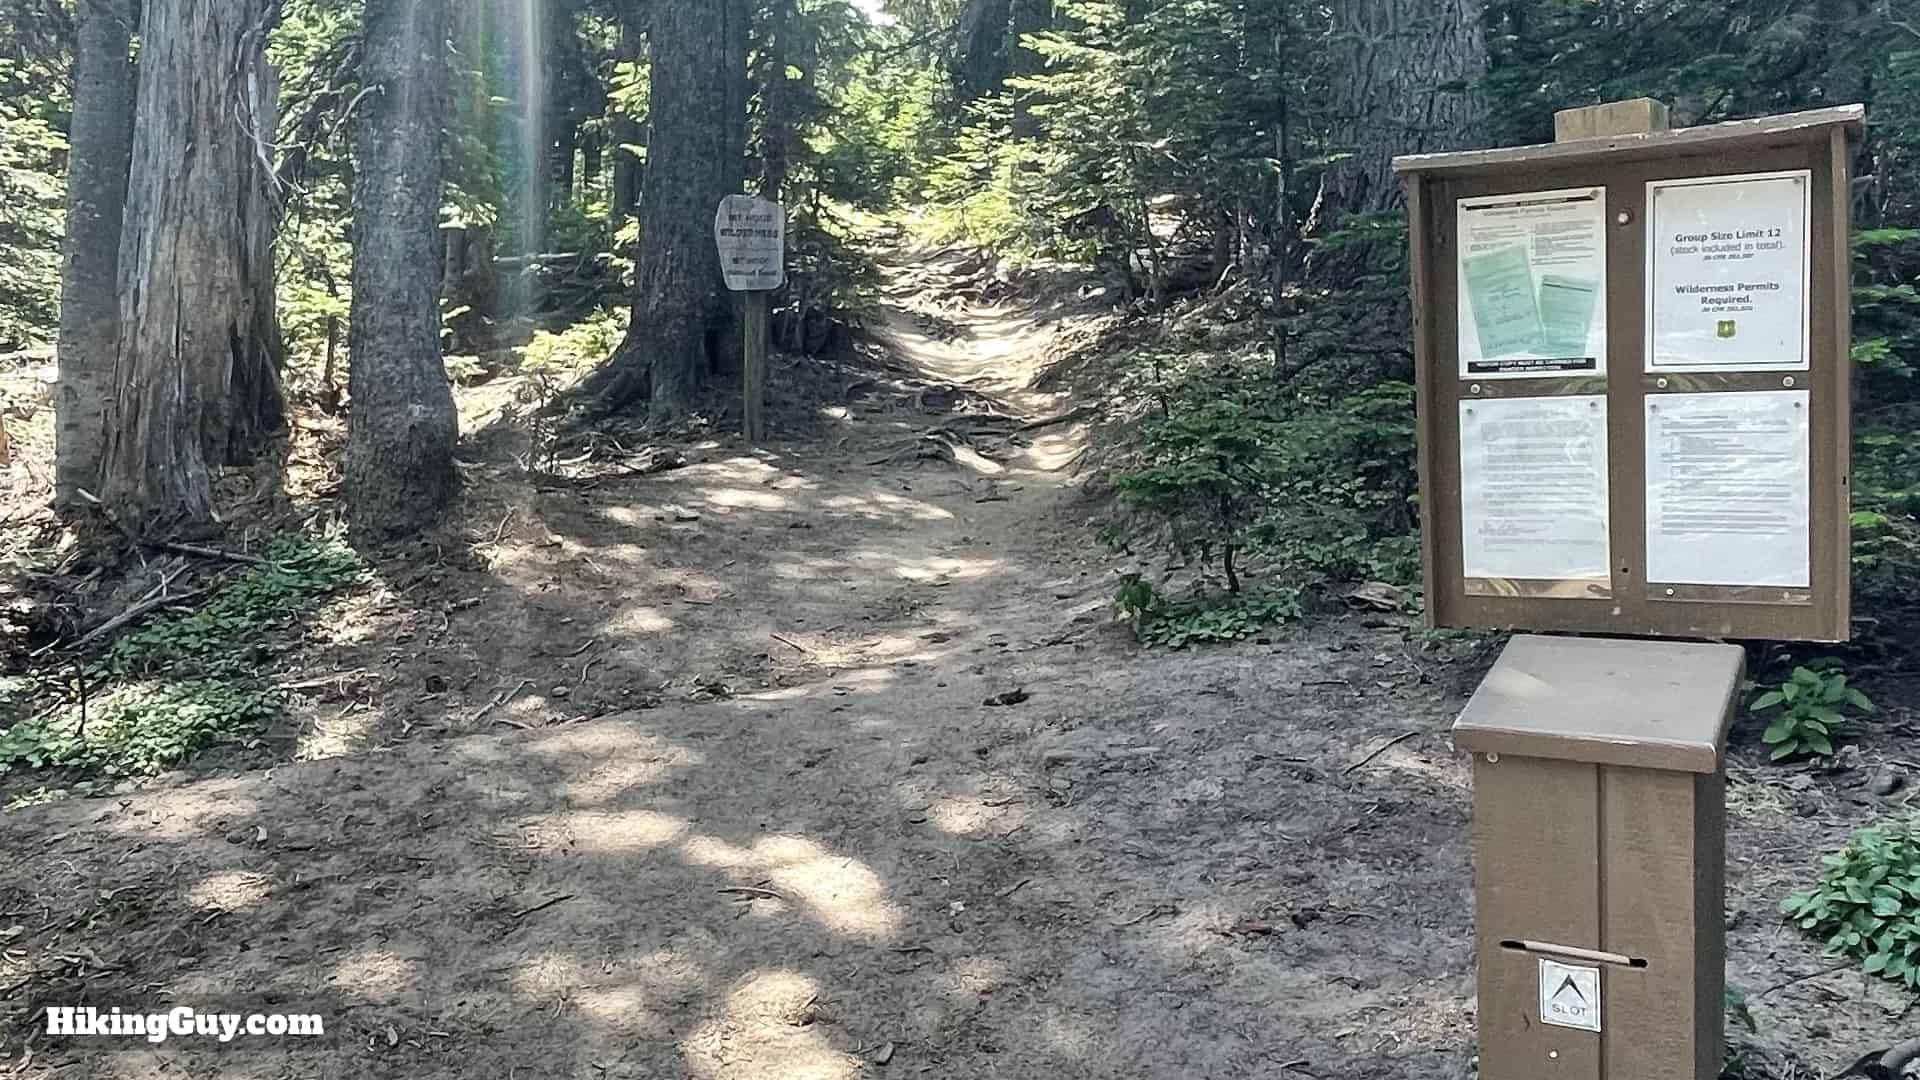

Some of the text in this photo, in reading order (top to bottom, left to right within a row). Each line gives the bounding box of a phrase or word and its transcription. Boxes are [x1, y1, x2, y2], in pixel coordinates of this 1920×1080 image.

[720, 228, 779, 238] WILDERNESS
[1675, 228, 1781, 243] Group Size Limit 12
[1702, 242, 1741, 253] included
[1744, 241, 1754, 251] in
[1675, 282, 1780, 294] Wilderness Permits
[1701, 294, 1752, 306] Required.
[1551, 1002, 1586, 1017] SLOT
